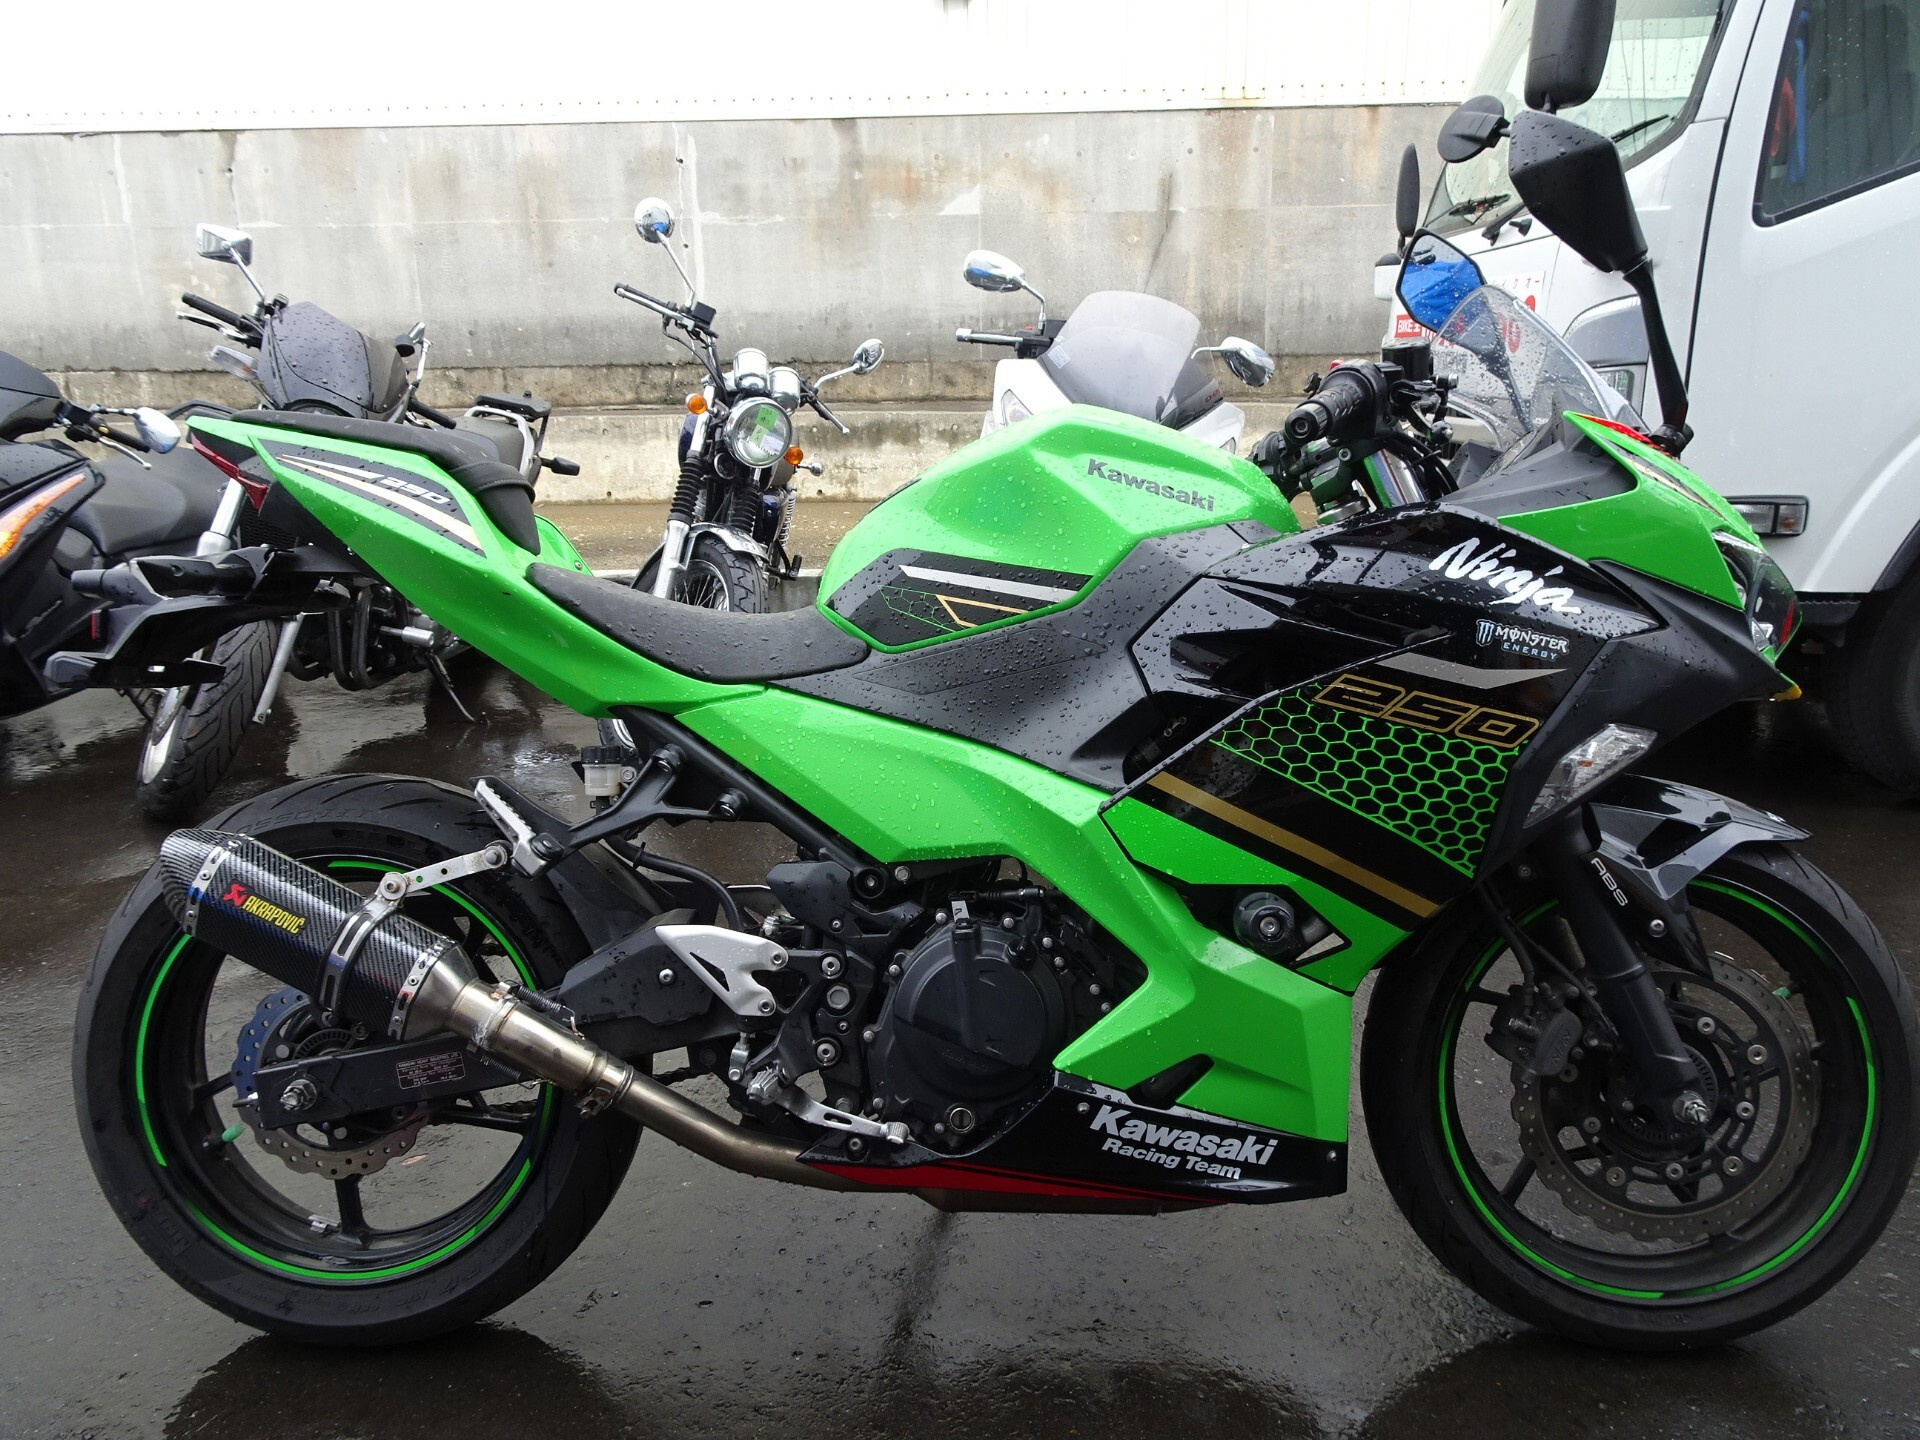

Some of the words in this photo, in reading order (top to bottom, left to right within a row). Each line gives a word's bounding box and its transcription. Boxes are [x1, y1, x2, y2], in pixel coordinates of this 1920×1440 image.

[380, 476, 451, 504] 250
[1087, 458, 1215, 512] Kawasaki
[1428, 537, 1582, 614] Ninja
[1503, 642, 1557, 660] ENERGY
[1312, 673, 1541, 748] 250
[1590, 857, 1628, 906] ABS
[1089, 1104, 1279, 1165] Kawasaki
[1101, 1137, 1181, 1169] Racing
[1186, 1155, 1242, 1180] Team
